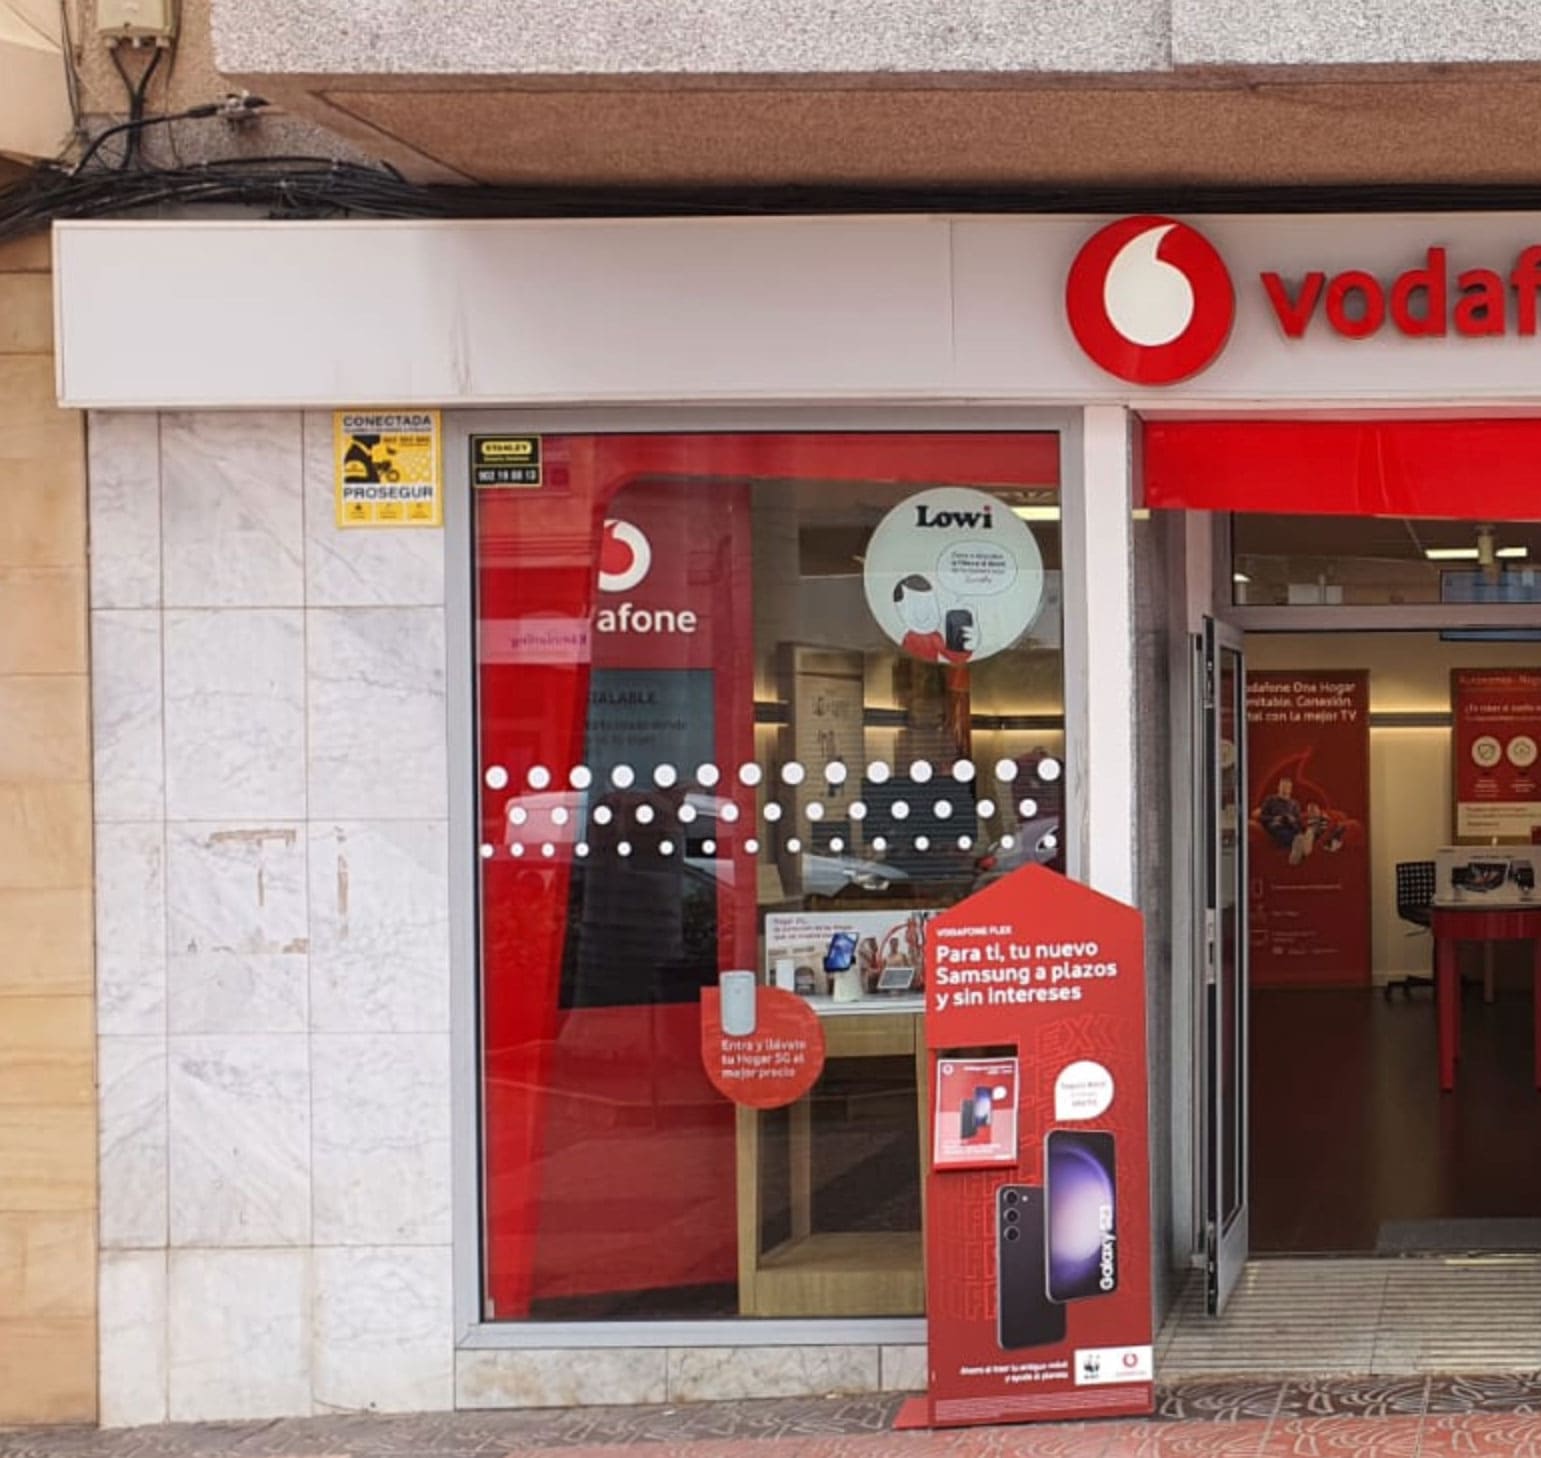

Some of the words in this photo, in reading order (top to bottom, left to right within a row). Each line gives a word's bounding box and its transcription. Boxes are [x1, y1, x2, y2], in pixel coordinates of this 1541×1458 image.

[343, 415, 431, 427] CONECTADA
[343, 486, 433, 498] PROSEGUR
[916, 505, 993, 529] Lowi
[596, 602, 697, 633] afone
[1320, 682, 1355, 696] Hogar
[1341, 710, 1357, 721] TV
[936, 926, 988, 937] VODAFONE
[989, 925, 1012, 935] FLEX
[936, 944, 982, 963] Para
[985, 942, 1005, 963] ti,
[1009, 943, 1031, 960] tu
[1035, 941, 1099, 959] nuevo
[936, 965, 1031, 985] Samsung
[1034, 967, 1047, 981] a
[1051, 961, 1118, 983] plazos
[936, 992, 950, 1011] y
[953, 987, 984, 1006] sin
[988, 985, 1082, 1005] intereses
[736, 1054, 772, 1067] Hogar
[1099, 1235, 1117, 1291] Galaxy
